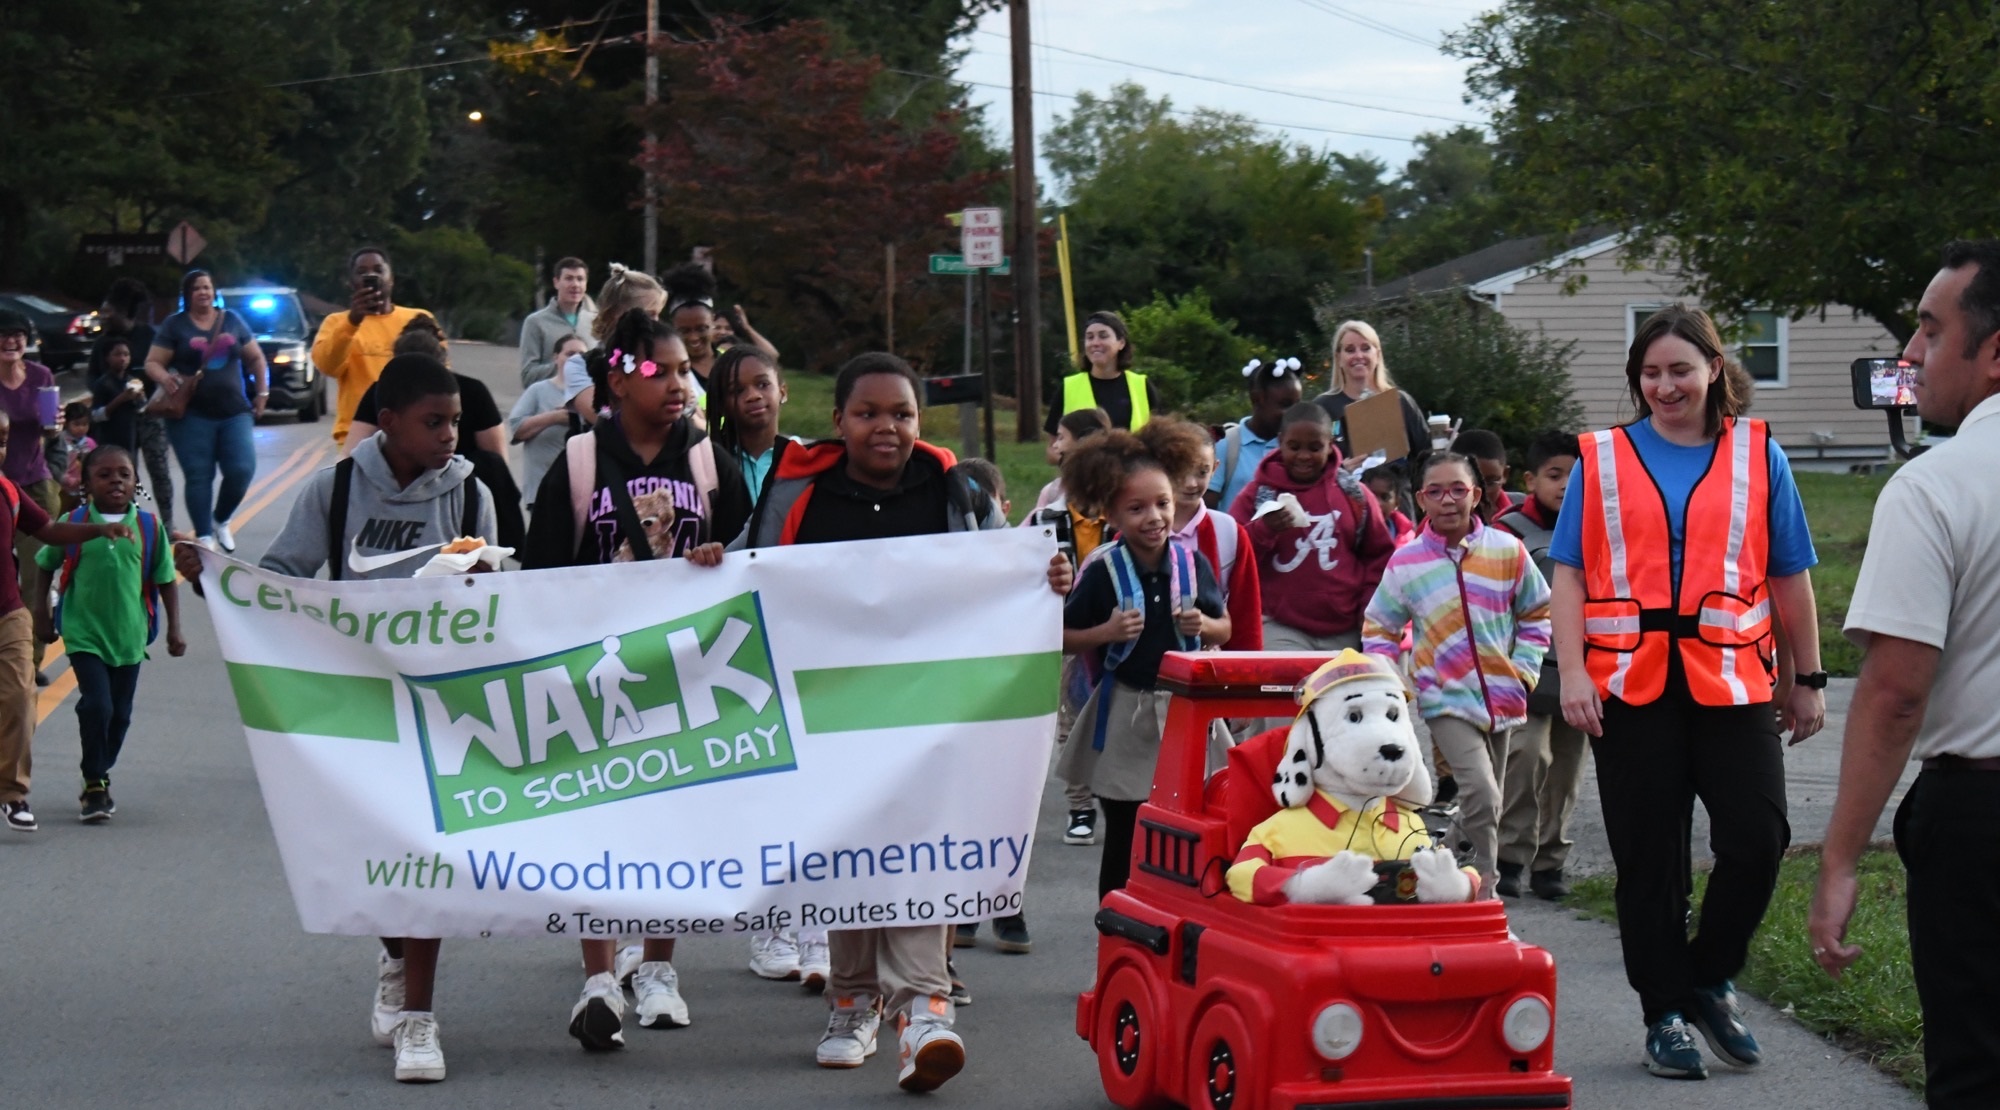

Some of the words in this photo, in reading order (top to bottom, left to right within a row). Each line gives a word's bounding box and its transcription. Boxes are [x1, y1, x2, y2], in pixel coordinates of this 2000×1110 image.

[964, 226, 1000, 237] PARKING
[974, 213, 989, 224] NO
[973, 253, 993, 262] TIME
[974, 241, 992, 250] ANY
[588, 476, 705, 522] CAIFORNIA
[356, 518, 427, 551] NIKE
[220, 564, 500, 645] Celebrate!
[414, 616, 774, 776] WALK
[453, 786, 507, 819] TO
[522, 748, 693, 809] SCHOOL
[703, 724, 780, 769] DAY
[366, 852, 454, 889] with
[467, 850, 743, 891] Woodmore
[760, 833, 1028, 887] Elementary
[546, 912, 566, 934] &
[572, 911, 724, 935] Tennessee
[733, 905, 792, 932] Safe
[801, 899, 897, 927] Routes
[905, 897, 934, 920] to
[943, 890, 1022, 918] Schoo
